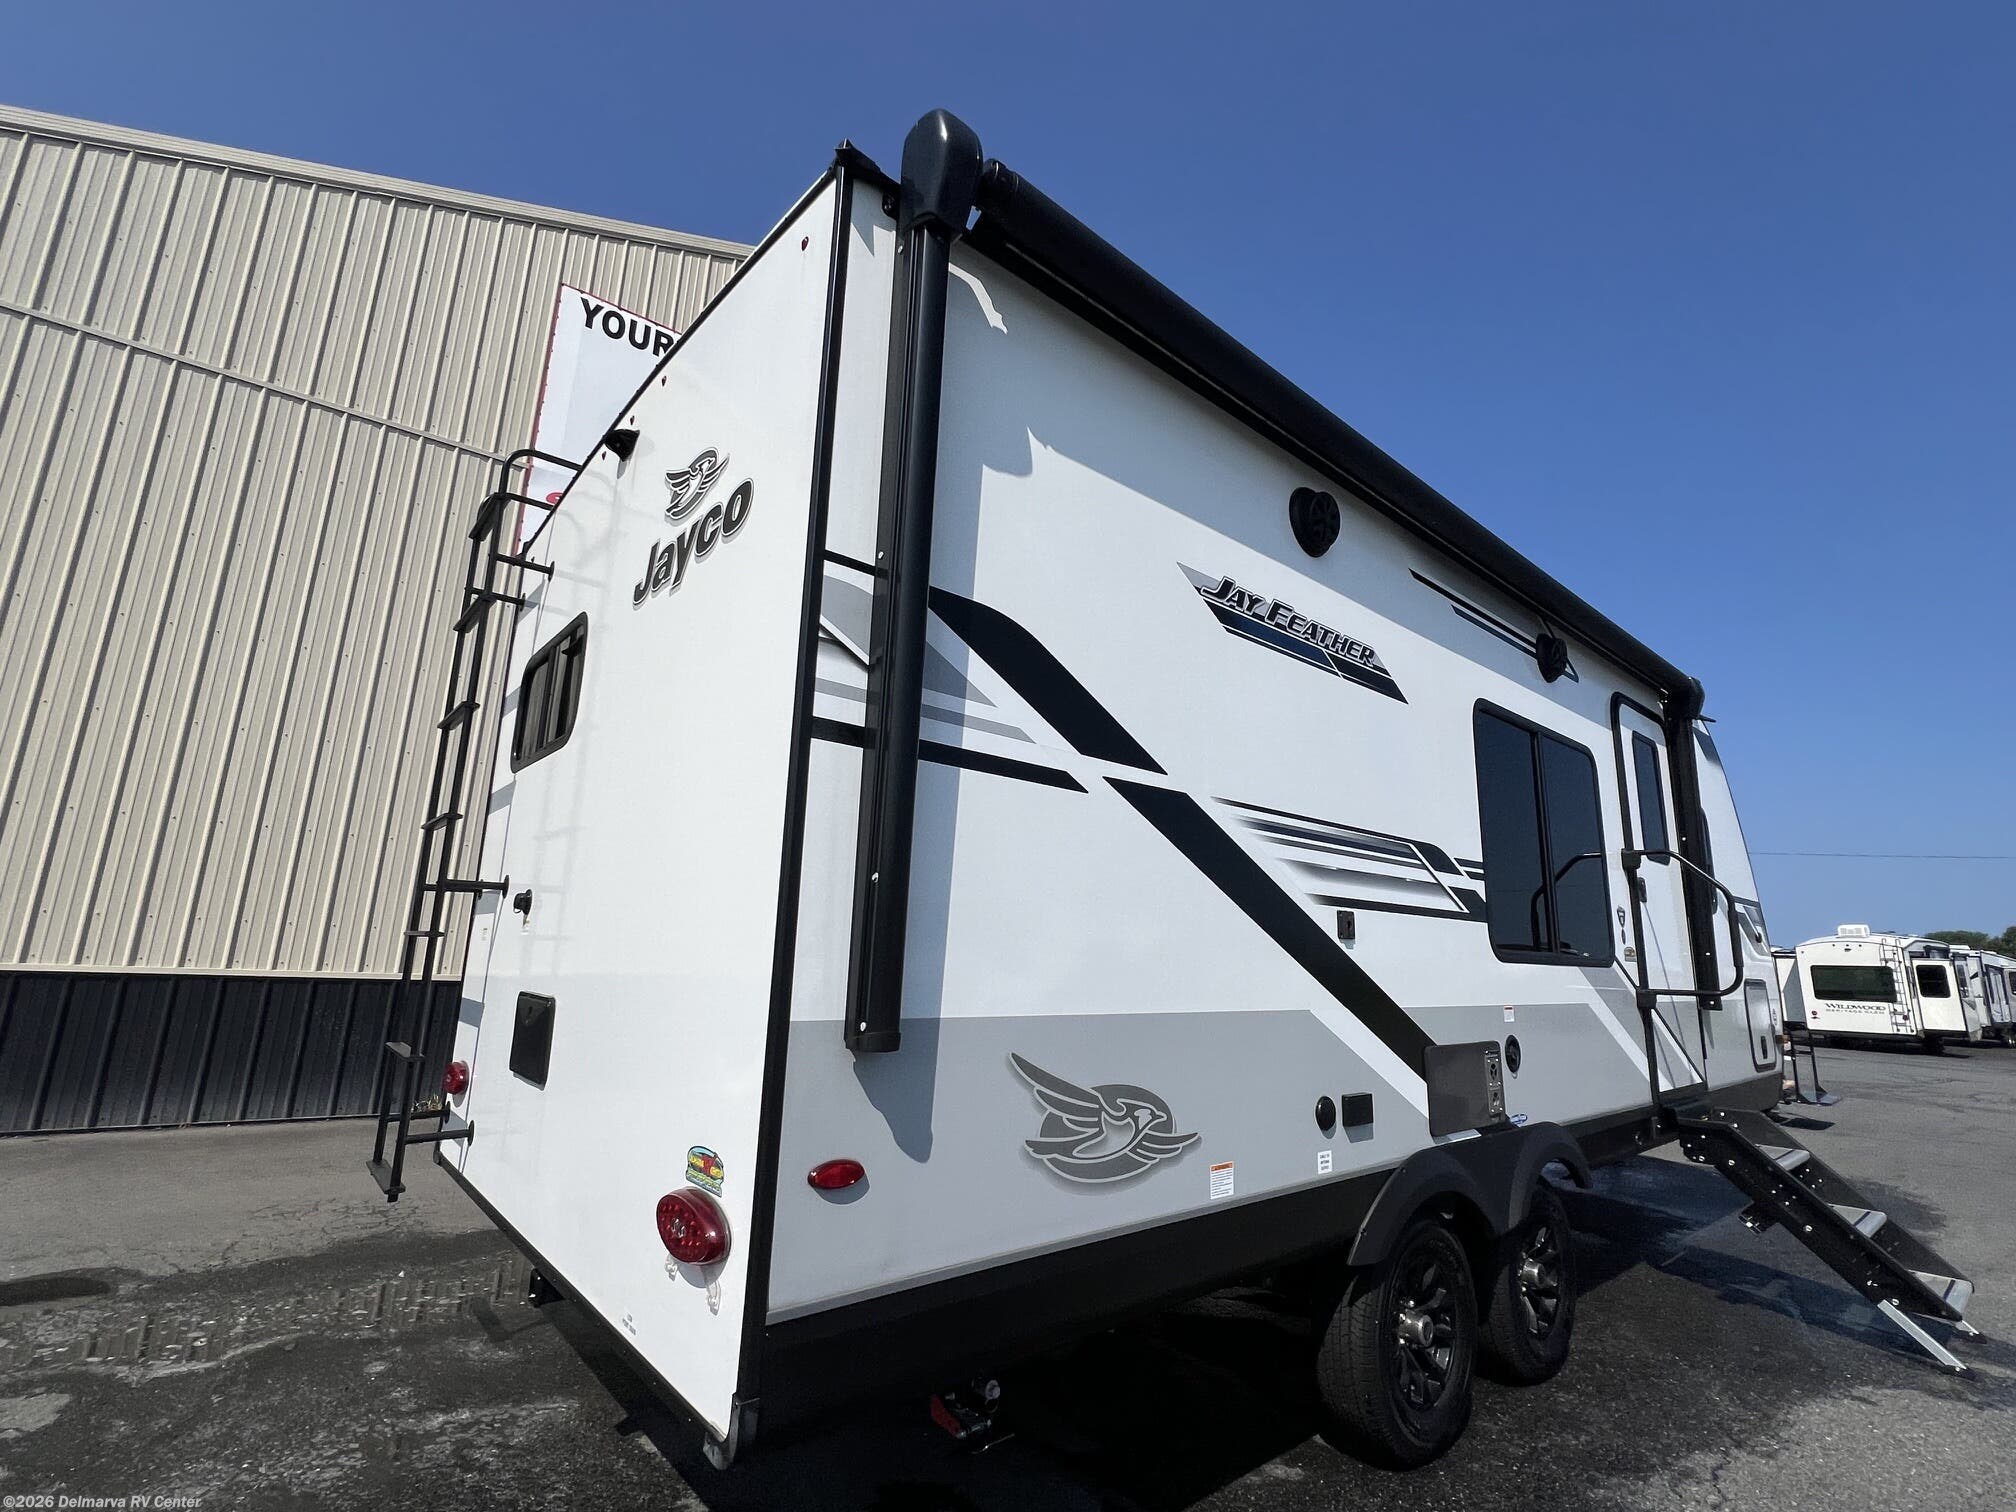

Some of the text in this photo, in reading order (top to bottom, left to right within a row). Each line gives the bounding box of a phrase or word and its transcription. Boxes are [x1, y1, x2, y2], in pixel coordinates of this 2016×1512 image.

[580, 297, 675, 357] YOUR
[633, 478, 754, 606] Jayco
[1264, 598, 1376, 667] FEATHER
[1825, 1003, 1886, 1011] WILDWOOD
